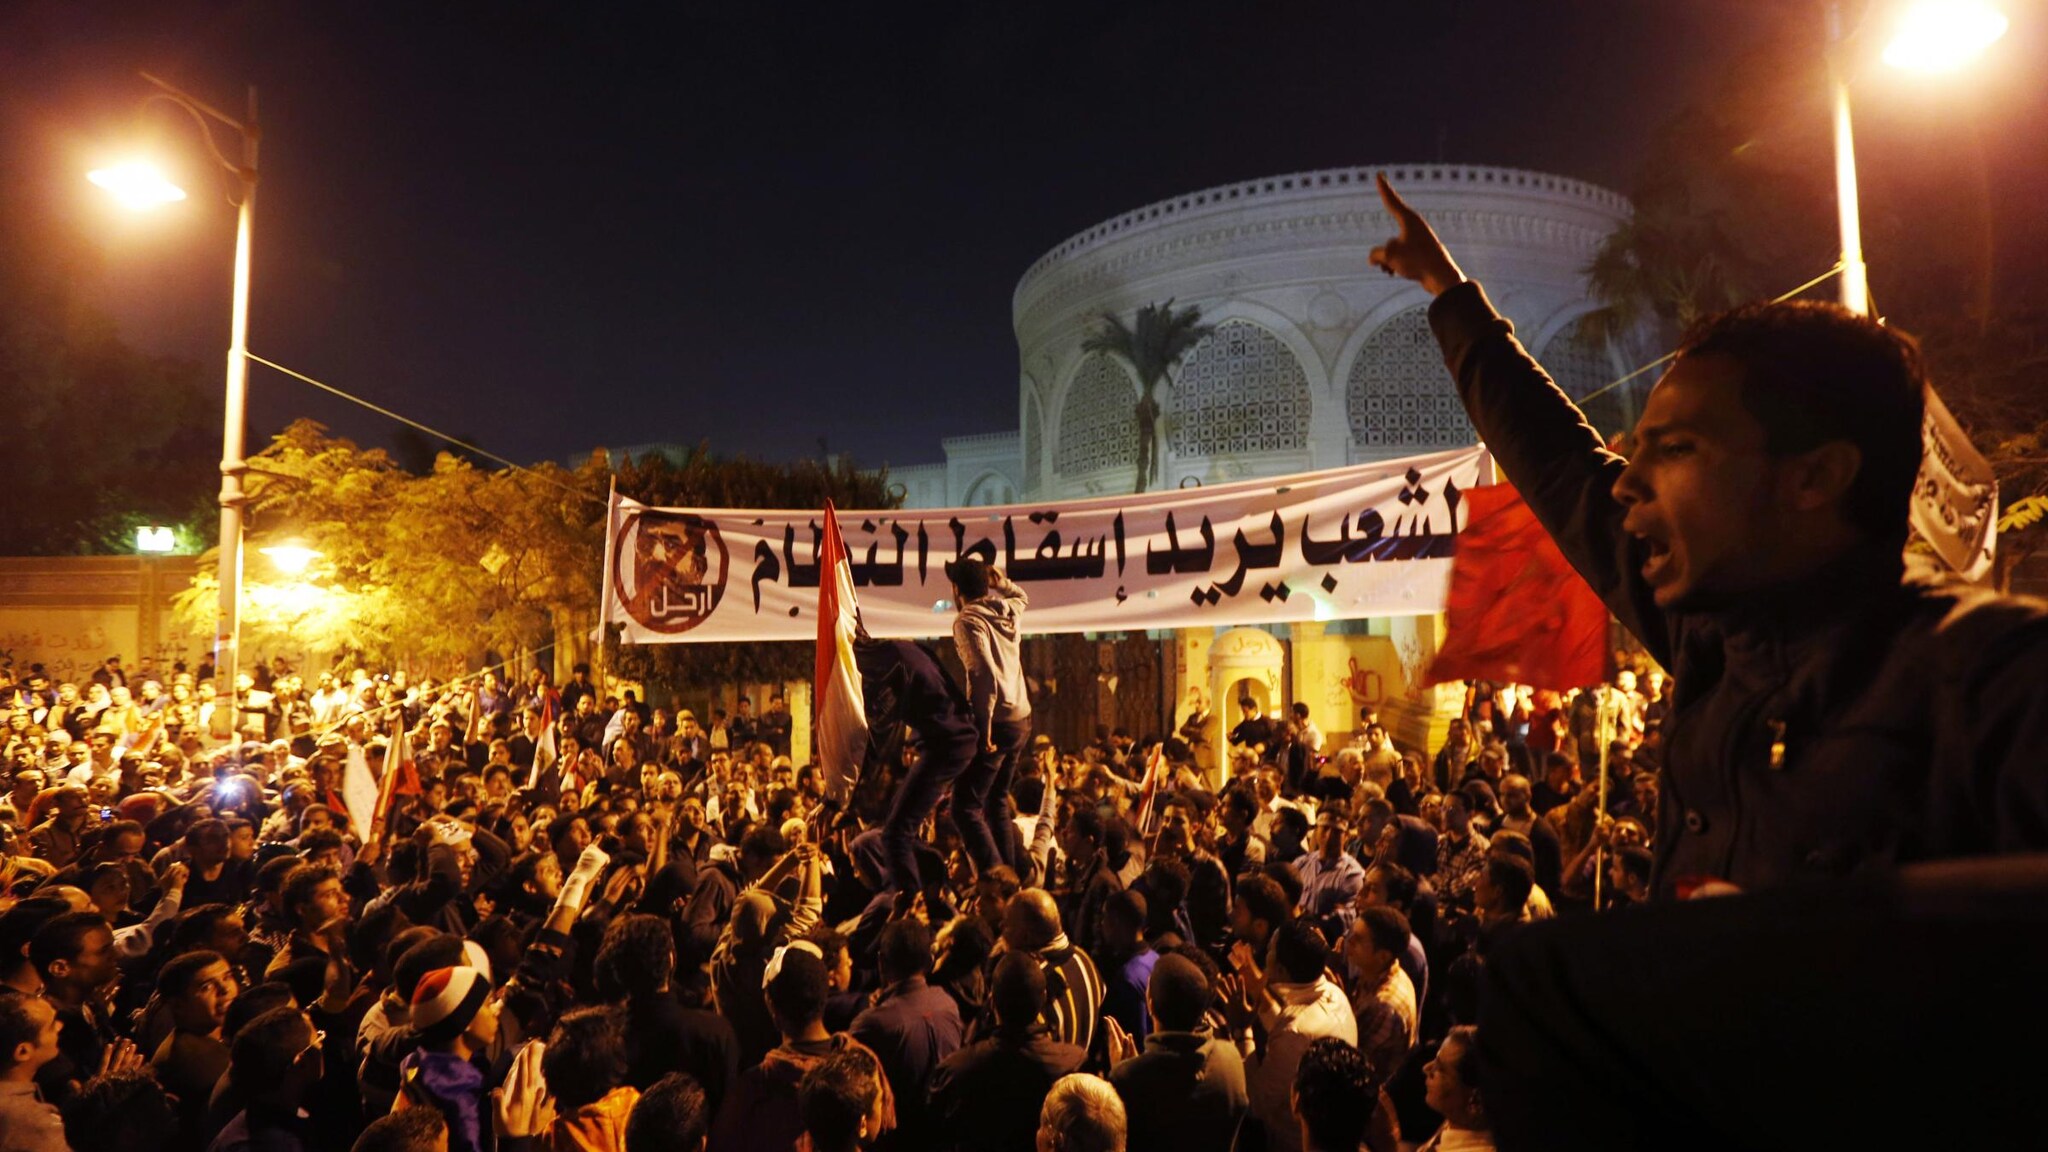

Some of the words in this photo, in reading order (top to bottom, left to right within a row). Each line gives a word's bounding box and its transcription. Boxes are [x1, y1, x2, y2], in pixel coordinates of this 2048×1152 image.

[1146, 509, 1291, 607] يريد
[1301, 467, 1480, 594] لشعب
[650, 583, 712, 617] ارحل
